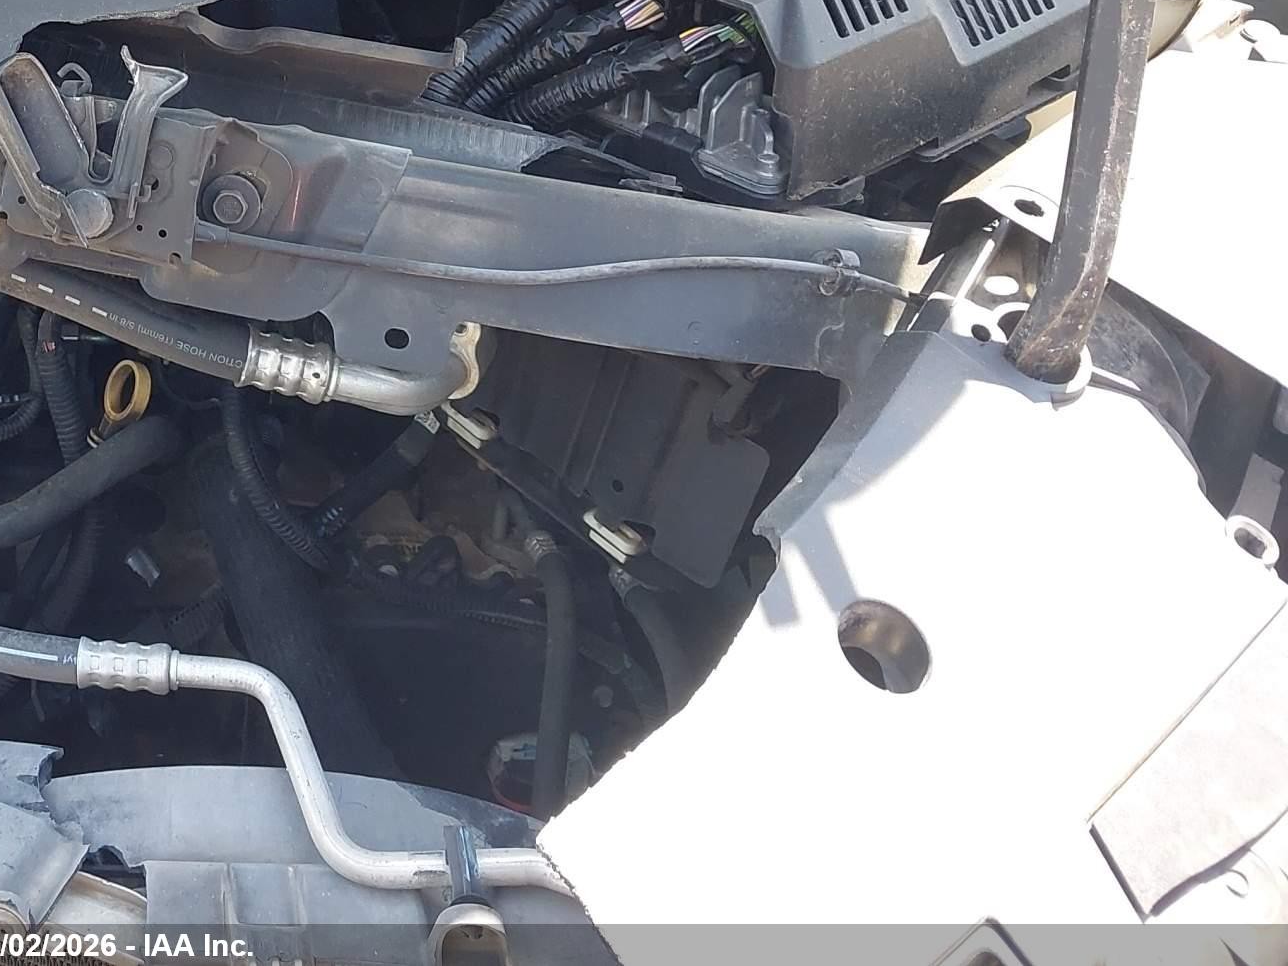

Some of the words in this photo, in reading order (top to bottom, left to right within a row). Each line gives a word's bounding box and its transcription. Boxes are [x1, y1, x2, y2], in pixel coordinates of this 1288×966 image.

[138, 324, 175, 345] (16mm)
[176, 340, 207, 358] HOSE
[208, 351, 243, 369] CTION
